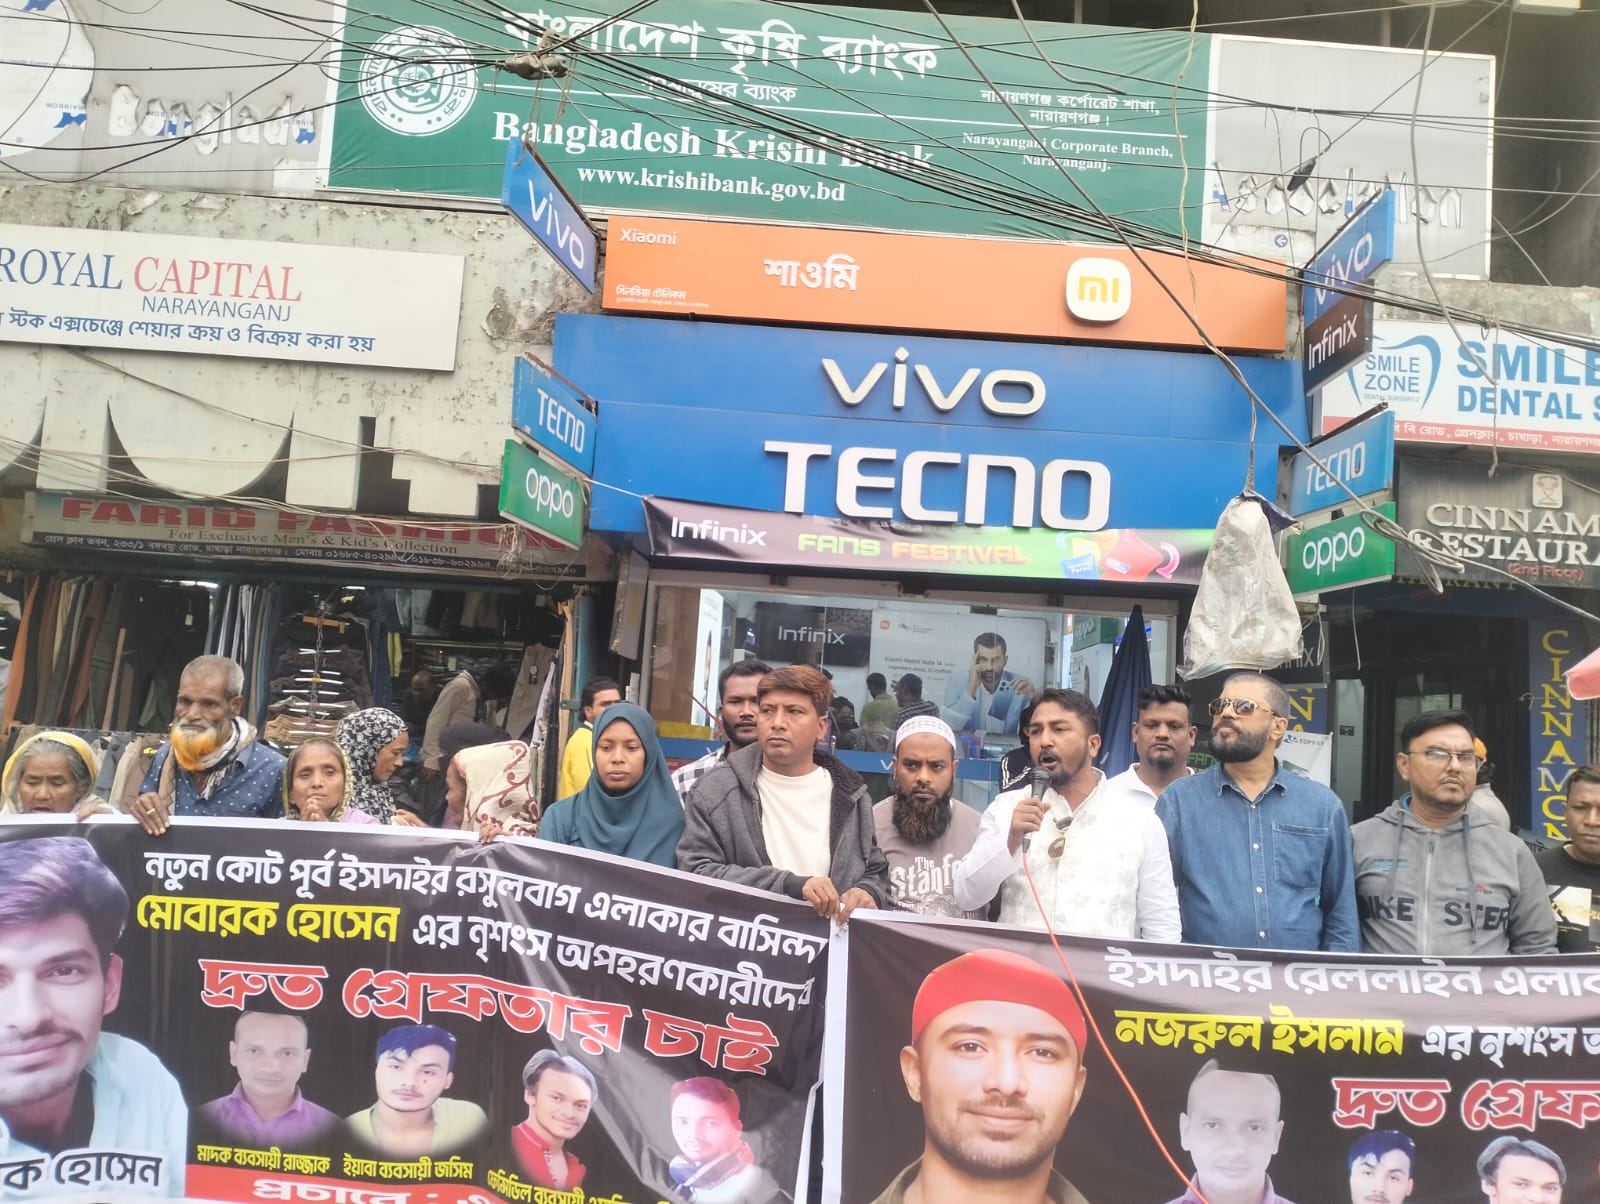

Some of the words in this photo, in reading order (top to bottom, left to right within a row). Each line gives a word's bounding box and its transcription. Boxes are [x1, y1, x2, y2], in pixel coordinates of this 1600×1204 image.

[717, 18, 807, 82] কৃষি
[817, 33, 942, 80] ব্যাংক
[743, 83, 798, 103] ব্যাংক
[492, 111, 700, 157] Bangladesh
[713, 127, 828, 167] Krishi
[1050, 138, 1118, 156] Corporate
[1121, 143, 1174, 159] Branch,
[577, 166, 846, 202] www.krishibank.gov.bd
[528, 179, 585, 270] vivo
[620, 228, 678, 245] Xiaomi
[0, 246, 123, 290] ROYAL
[134, 256, 302, 302] CAPITAL
[763, 253, 860, 292] শাওমি
[1314, 231, 1374, 306] vivo
[9, 306, 46, 328] স্টক
[129, 320, 183, 339] শেয়ার
[188, 324, 224, 343] ক্রয়
[227, 326, 241, 342] ও
[248, 324, 302, 349] বিক্রয়
[306, 333, 344, 351] করা
[348, 335, 376, 353] হয়
[142, 295, 292, 323] NARAYANGANJ
[1307, 313, 1359, 372] Infinix
[1365, 353, 1421, 374] SMILE
[821, 346, 1047, 418] vivo
[1364, 374, 1421, 393] ZONE
[1457, 385, 1583, 421] DENTAL
[537, 387, 586, 454] TECNO
[525, 467, 574, 519] oppo
[764, 439, 1112, 532] TECNO
[1305, 441, 1366, 496] TECNO
[61, 497, 256, 530] FARID
[169, 529, 194, 540] For
[201, 530, 268, 543] Exclusive
[273, 533, 317, 545] Men's
[321, 535, 335, 545] &
[341, 536, 379, 547] Kid's
[384, 539, 457, 554] Collection
[670, 517, 768, 547] Infinix
[797, 533, 881, 558] FANS
[891, 541, 1032, 566] FESTIVAL
[1302, 526, 1366, 576] oppo
[778, 625, 847, 646] Infinix
[914, 856, 935, 872] The
[143, 852, 211, 891] নতুন
[216, 849, 285, 885] কোট
[289, 849, 337, 899] পূর্ব
[338, 852, 452, 896] ইসদাইর
[584, 891, 713, 942] এলাকার
[137, 895, 280, 938] মোবারক
[286, 903, 401, 943] হোসেন
[412, 914, 462, 950] এর
[468, 915, 553, 962] নৃশংস
[1104, 946, 1273, 994] ইসদাইর
[1285, 957, 1483, 998] রেললাইন
[198, 958, 329, 1011] দ্রুত
[342, 968, 633, 1056] গ্রেফতার
[642, 1007, 780, 1076] চাই
[1114, 1009, 1264, 1055] নজরুল
[1269, 1002, 1406, 1057] ইসলাম
[1422, 1025, 1474, 1061] এর
[1477, 1025, 1578, 1069] নৃশংস
[1331, 1077, 1452, 1131] দ্রুত
[54, 1151, 163, 1188] হোসেন
[197, 1144, 233, 1164] মাদক
[233, 1146, 281, 1171] ব্যবসায়ী
[343, 1152, 378, 1177] ইয়াবা
[378, 1155, 433, 1181] ব্যবসায়ী
